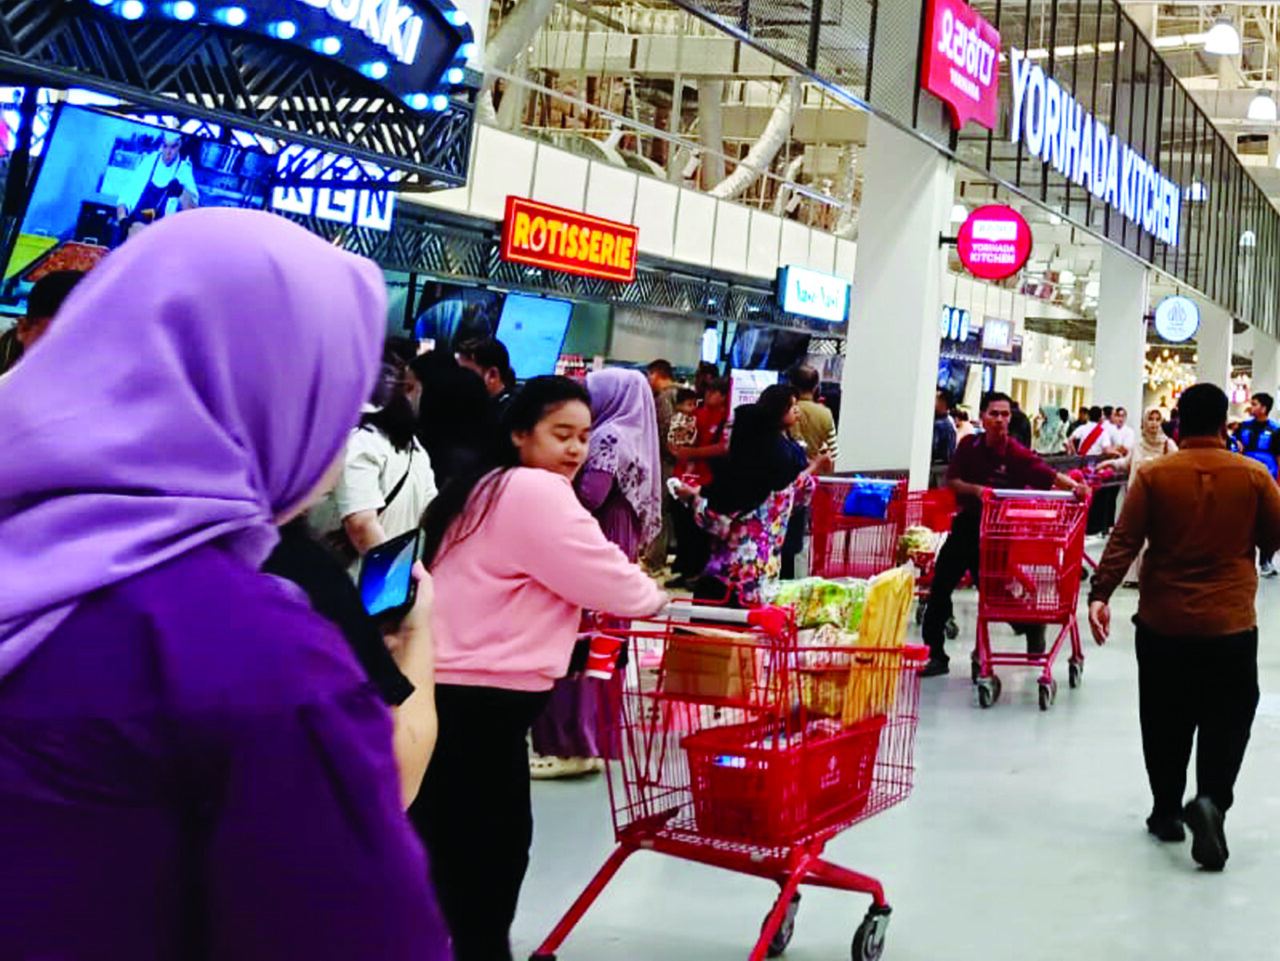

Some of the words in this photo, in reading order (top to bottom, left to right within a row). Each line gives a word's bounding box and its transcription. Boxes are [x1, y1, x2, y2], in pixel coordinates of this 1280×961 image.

[1010, 46, 1119, 210] YORIHADA
[1121, 142, 1182, 246] KITCHEN
[513, 211, 632, 269] ROTISSERIE
[970, 252, 1016, 264] KITCHEN
